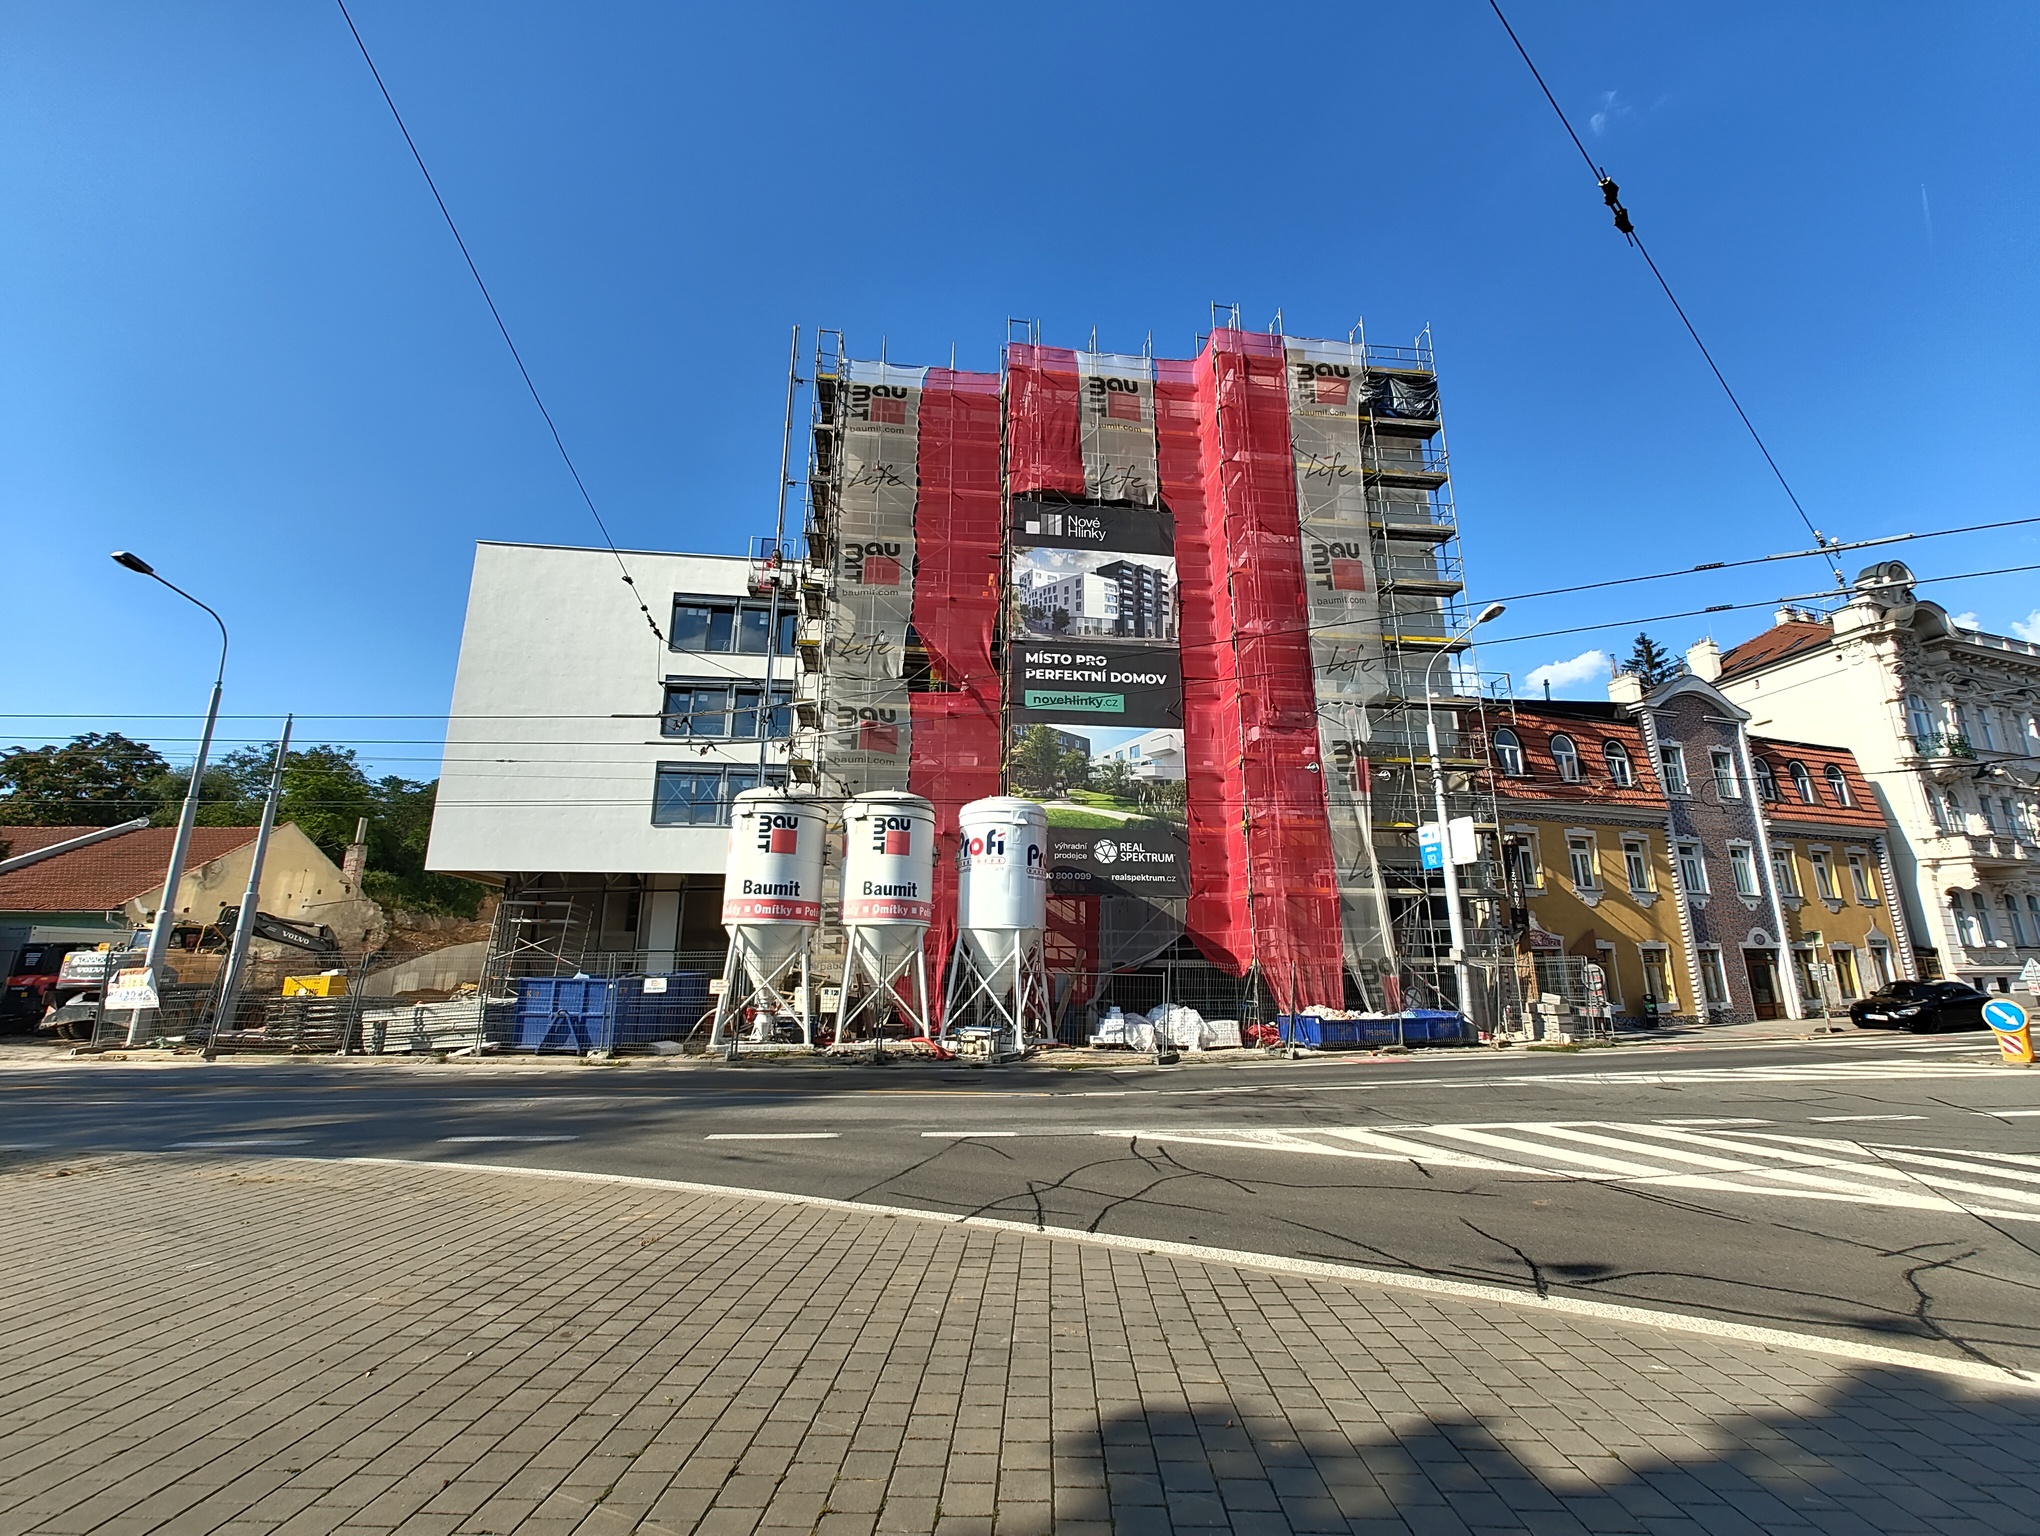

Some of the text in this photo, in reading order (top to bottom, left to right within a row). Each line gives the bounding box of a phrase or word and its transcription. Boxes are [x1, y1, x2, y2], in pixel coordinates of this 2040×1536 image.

[1067, 515, 1101, 528] Nové
[1067, 527, 1107, 541] Hlinky
[1316, 596, 1367, 606] baumit.com
[1025, 651, 1108, 667] MÍSTO PRO
[1025, 668, 1168, 685] PERFEKTNÍ DOMOV
[1033, 694, 1119, 708] novehlinky.cz
[1054, 842, 1088, 851] výhradní
[1120, 842, 1146, 852] REAL
[1054, 852, 1088, 861] prodejce
[1120, 852, 1175, 863] SPEKTRUM
[1056, 872, 1074, 880] 800
[1074, 872, 1092, 880] 099
[1111, 873, 1177, 883] realspektrum.cz
[743, 879, 801, 898] Baumit
[863, 881, 918, 898] Baumit
[753, 903, 793, 917] Omítky
[872, 904, 909, 916] Omítky
[282, 930, 310, 945] VOLVO
